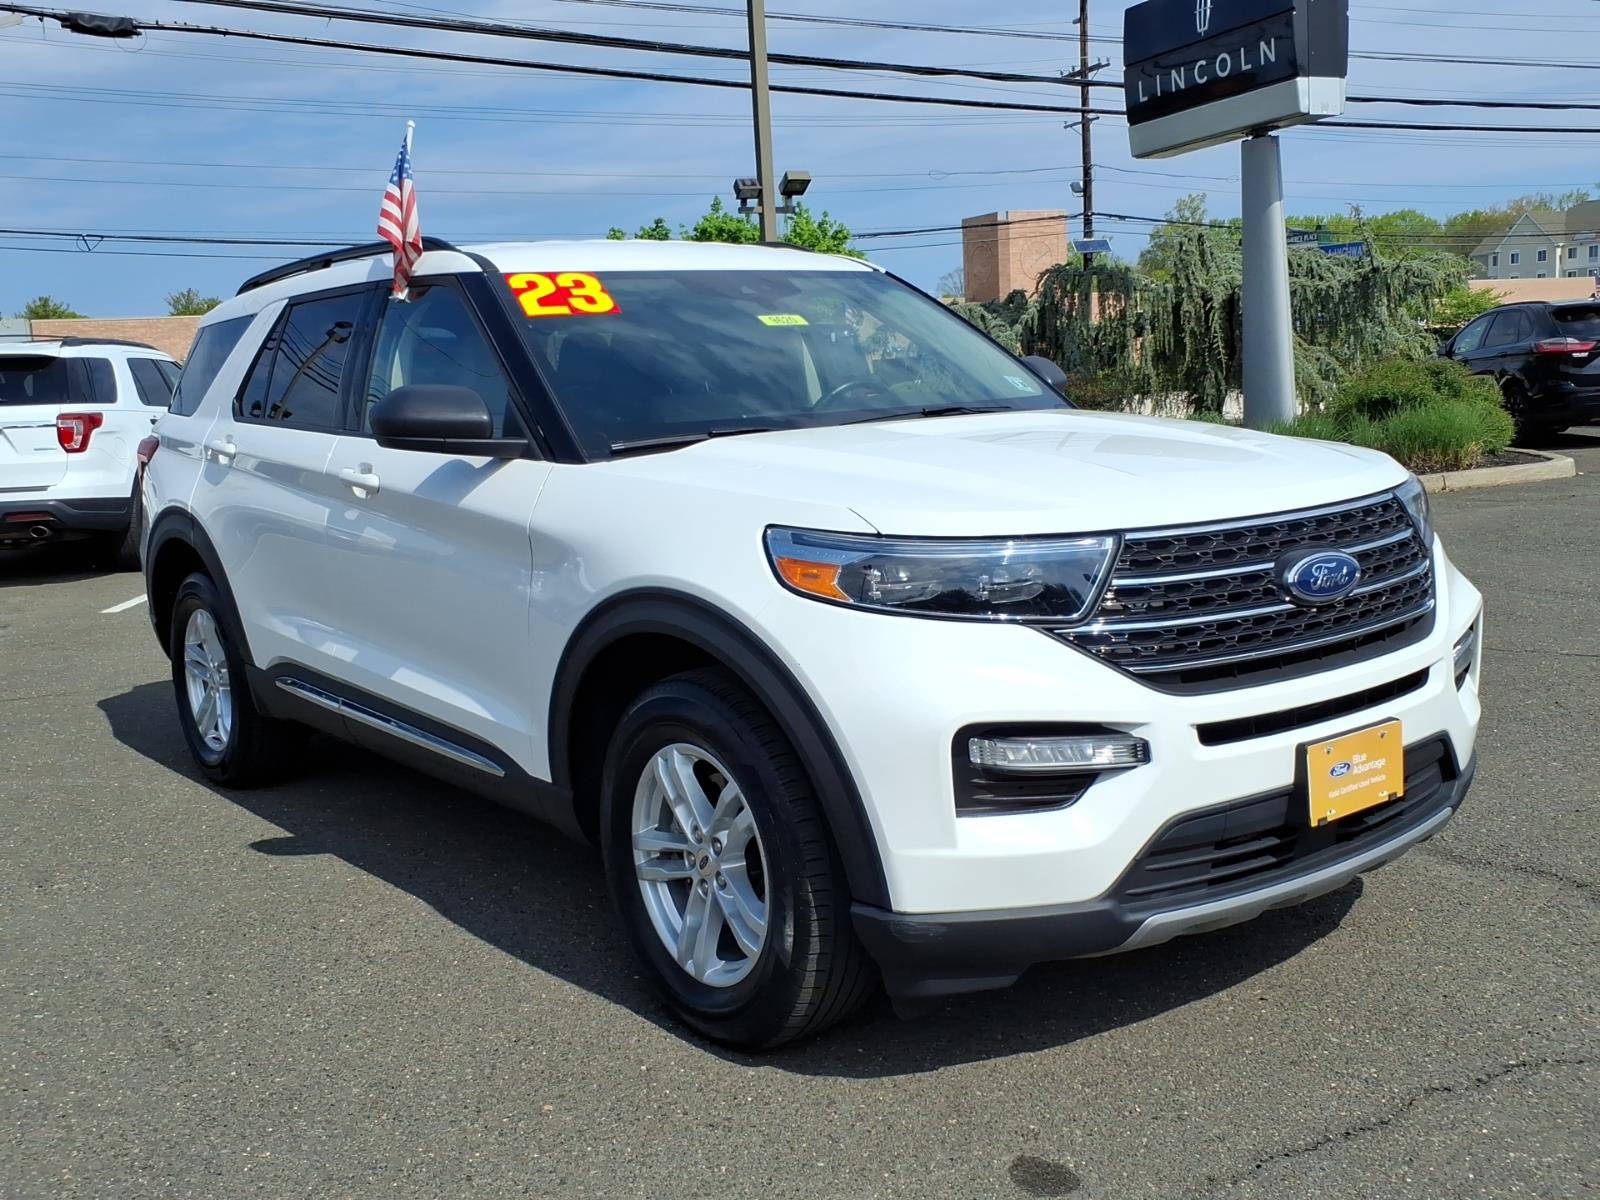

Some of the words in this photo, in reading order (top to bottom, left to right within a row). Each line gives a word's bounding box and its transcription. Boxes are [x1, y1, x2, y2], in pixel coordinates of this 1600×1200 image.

[1138, 37, 1276, 102] LINCOLN
[508, 272, 615, 317] 23
[1310, 562, 1349, 590] Ford
[1331, 763, 1350, 776] Ford
[1352, 758, 1386, 774] Advantage
[1352, 753, 1367, 764] Blue
